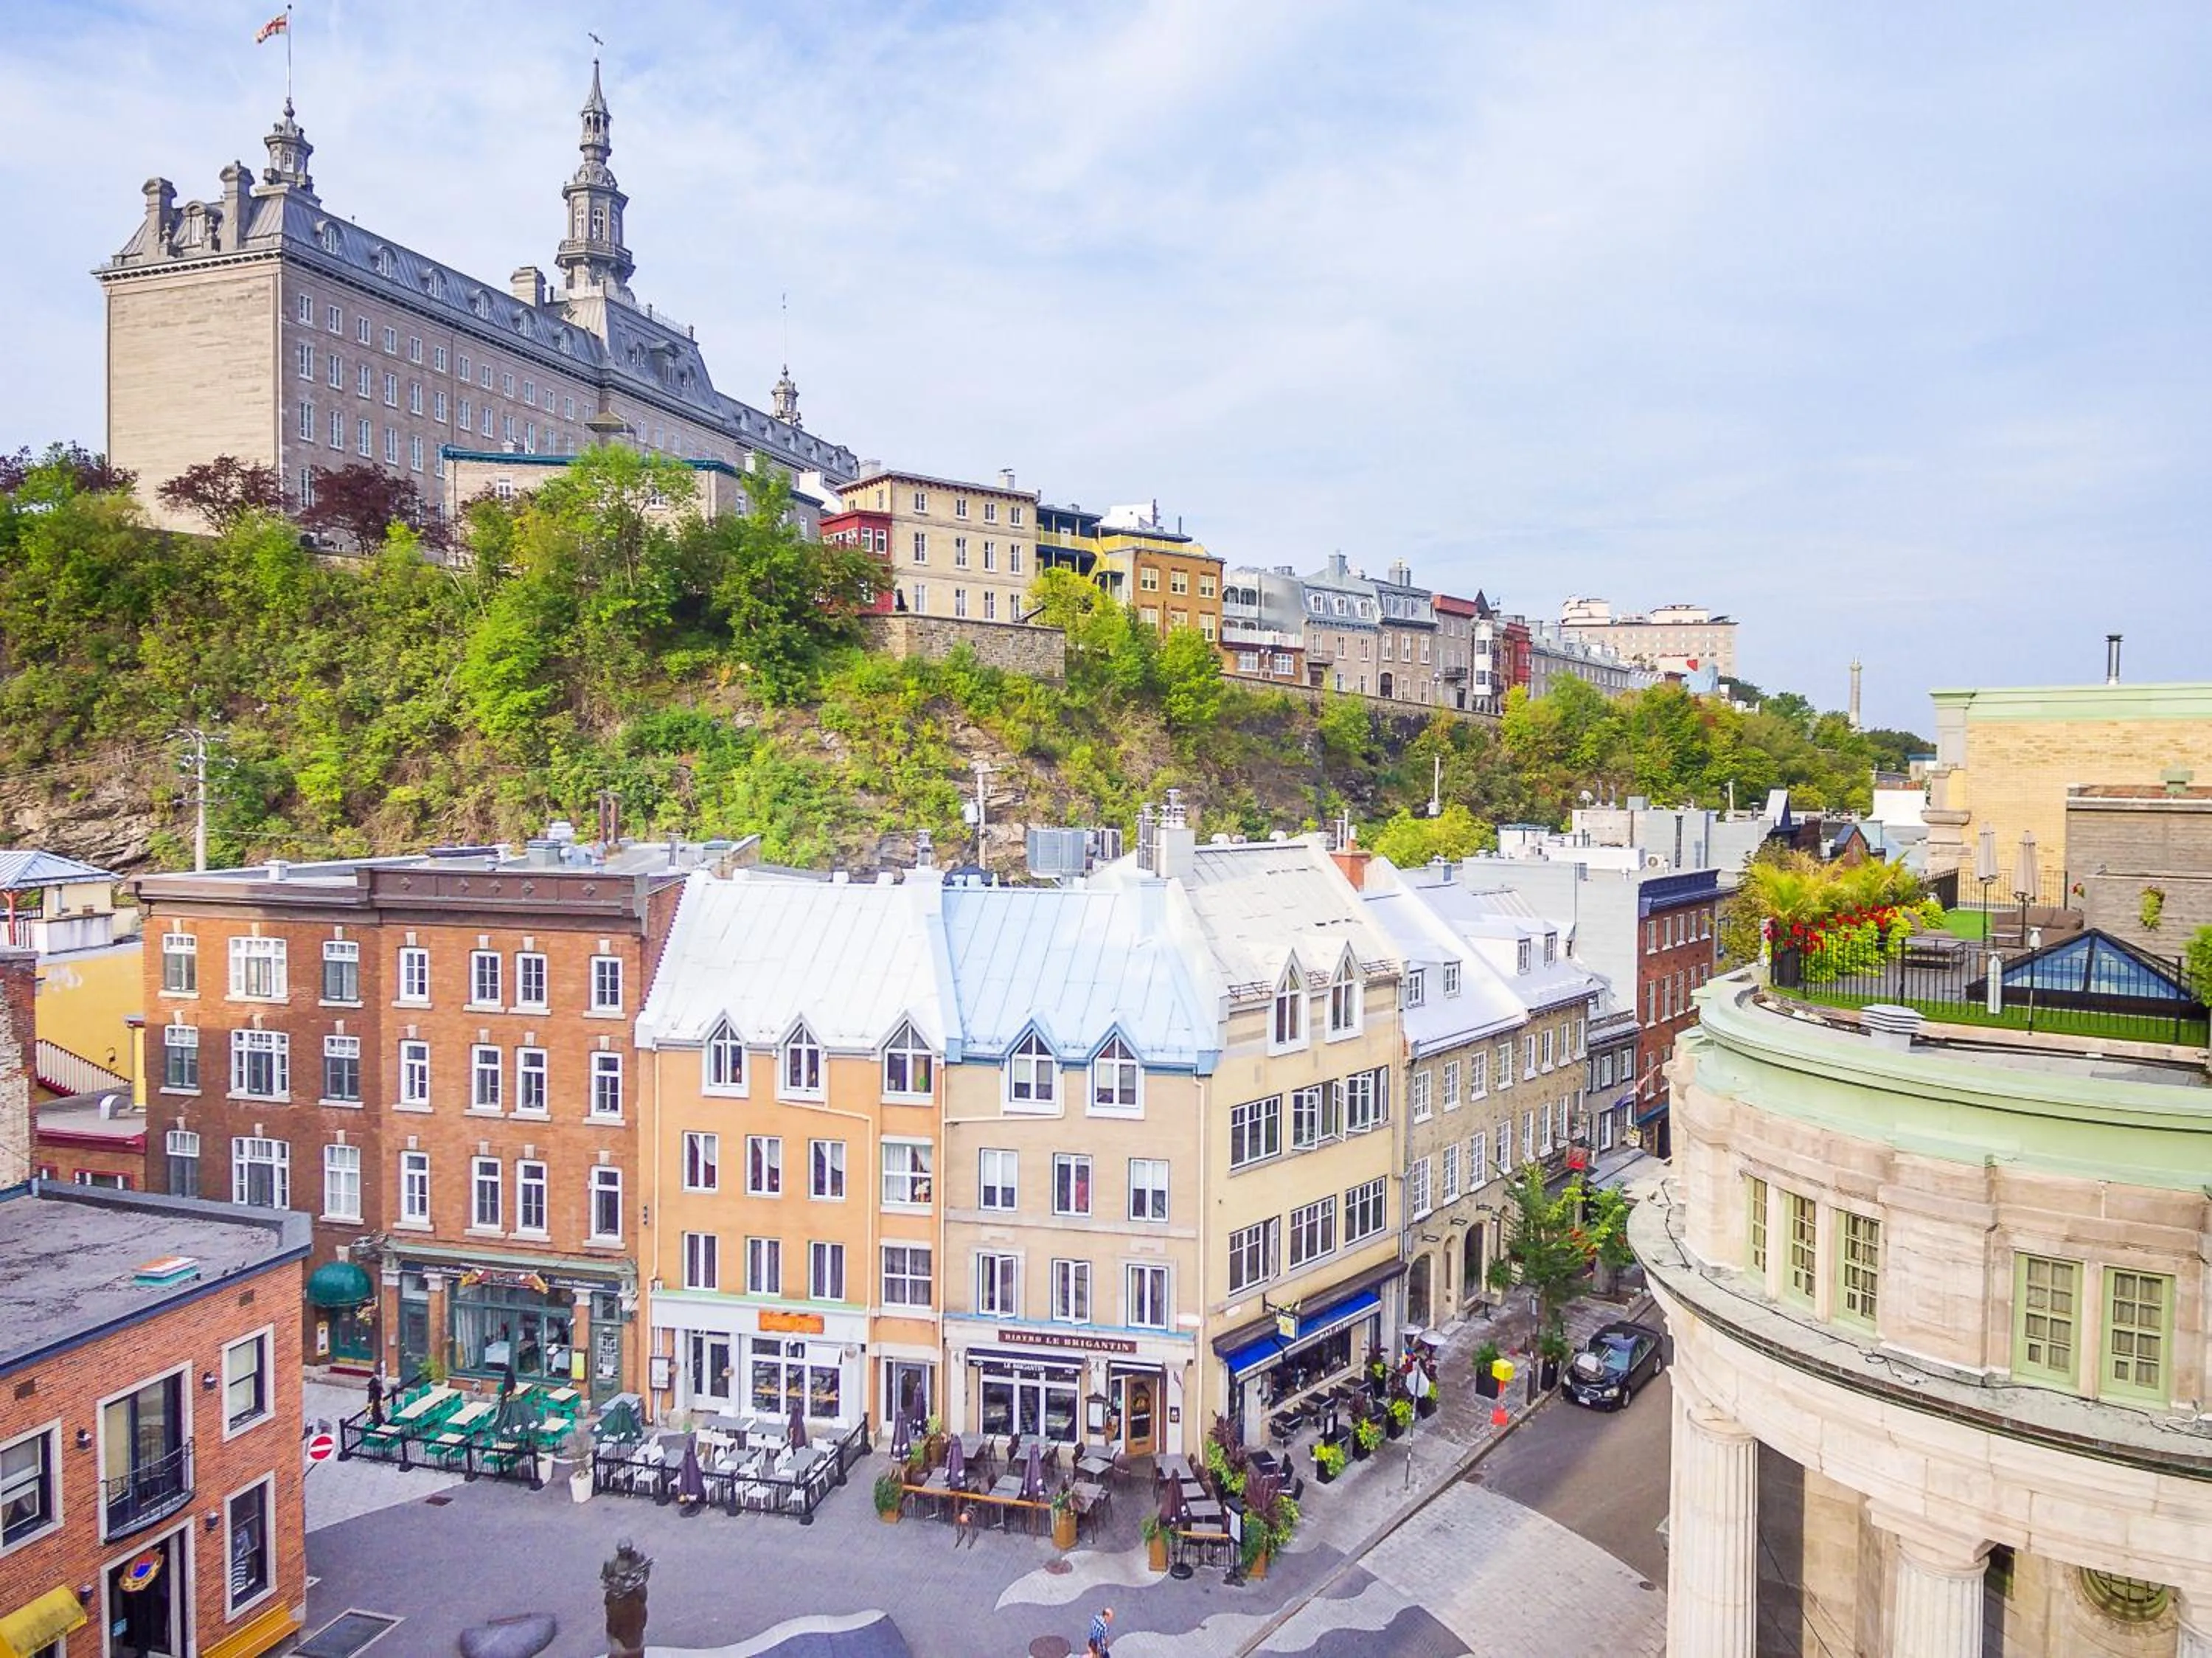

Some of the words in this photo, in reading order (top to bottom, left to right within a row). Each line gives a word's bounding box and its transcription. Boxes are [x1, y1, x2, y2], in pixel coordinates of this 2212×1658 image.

[1004, 1333, 1042, 1343] BISTRO
[1046, 1336, 1060, 1345] LE
[1064, 1339, 1130, 1351] BRIGANTIN
